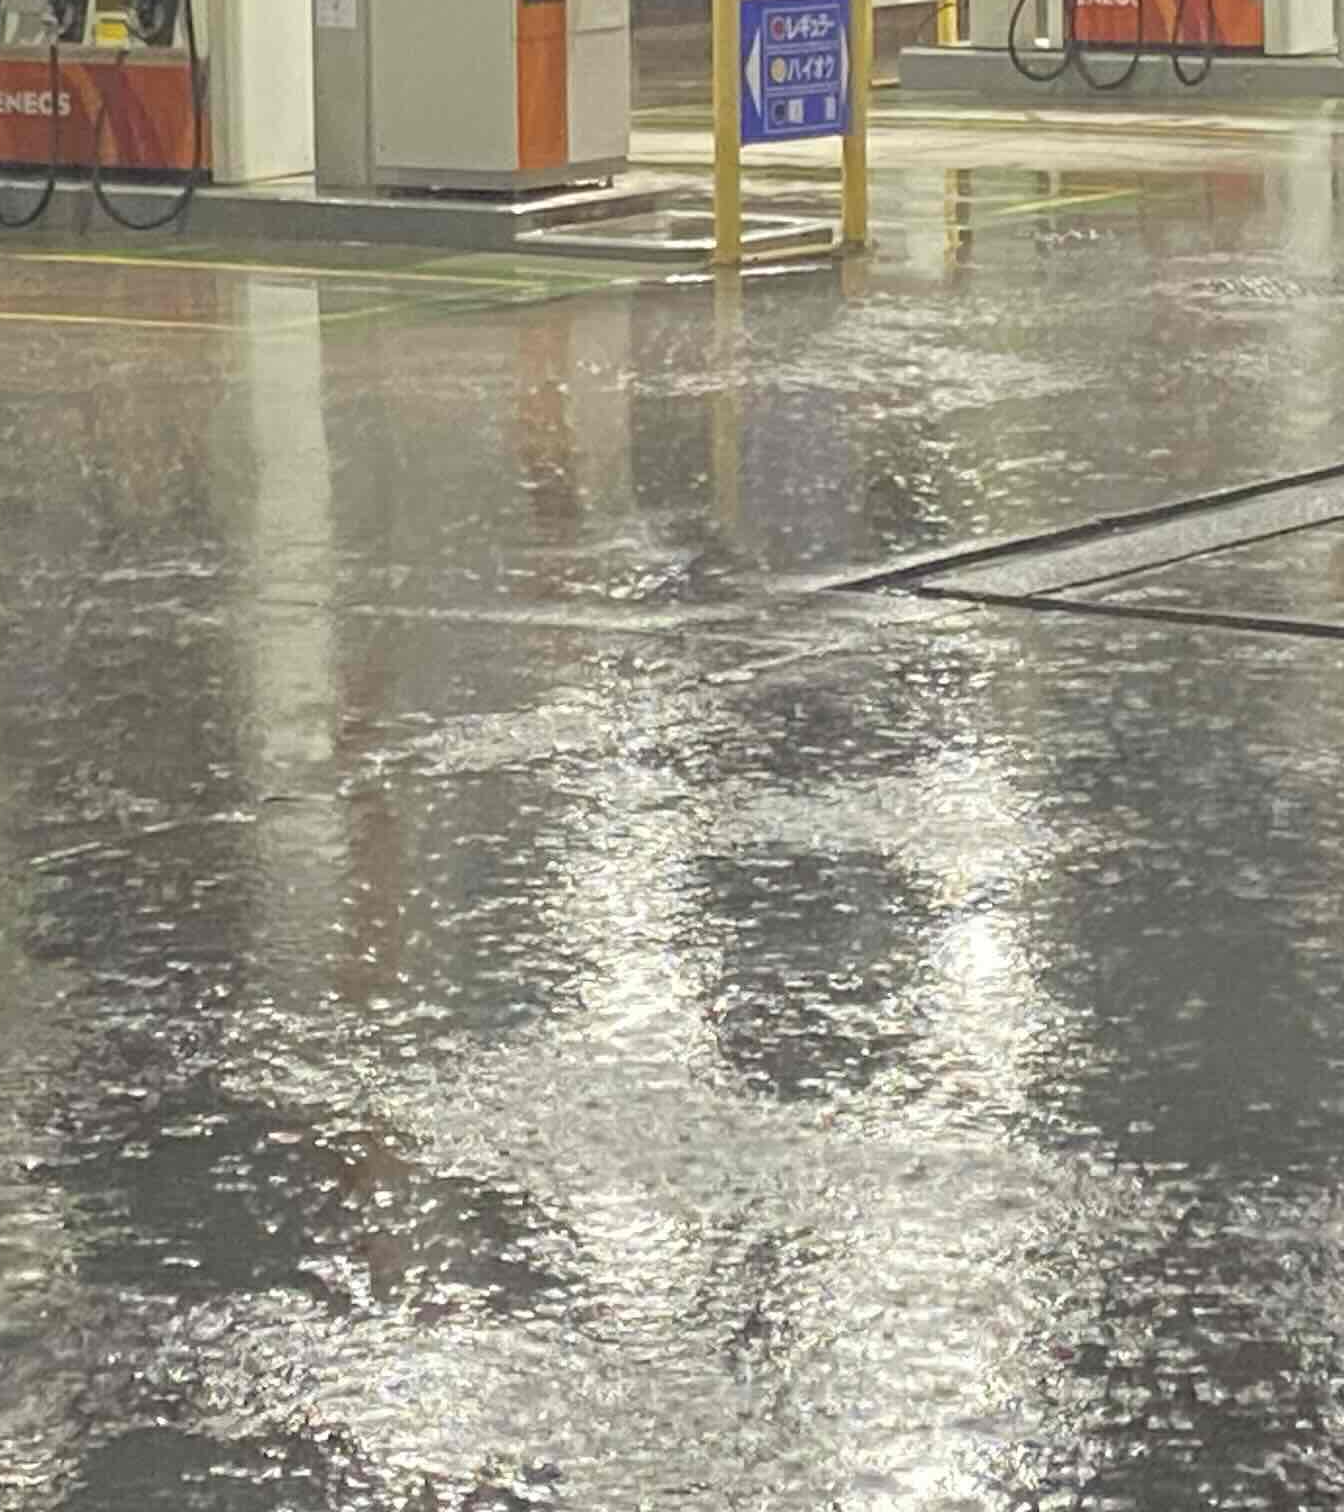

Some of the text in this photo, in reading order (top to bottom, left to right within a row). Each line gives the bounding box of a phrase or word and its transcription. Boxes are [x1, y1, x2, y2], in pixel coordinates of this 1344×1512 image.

[785, 12, 835, 40] レギュラー
[787, 53, 835, 83] ハイオク
